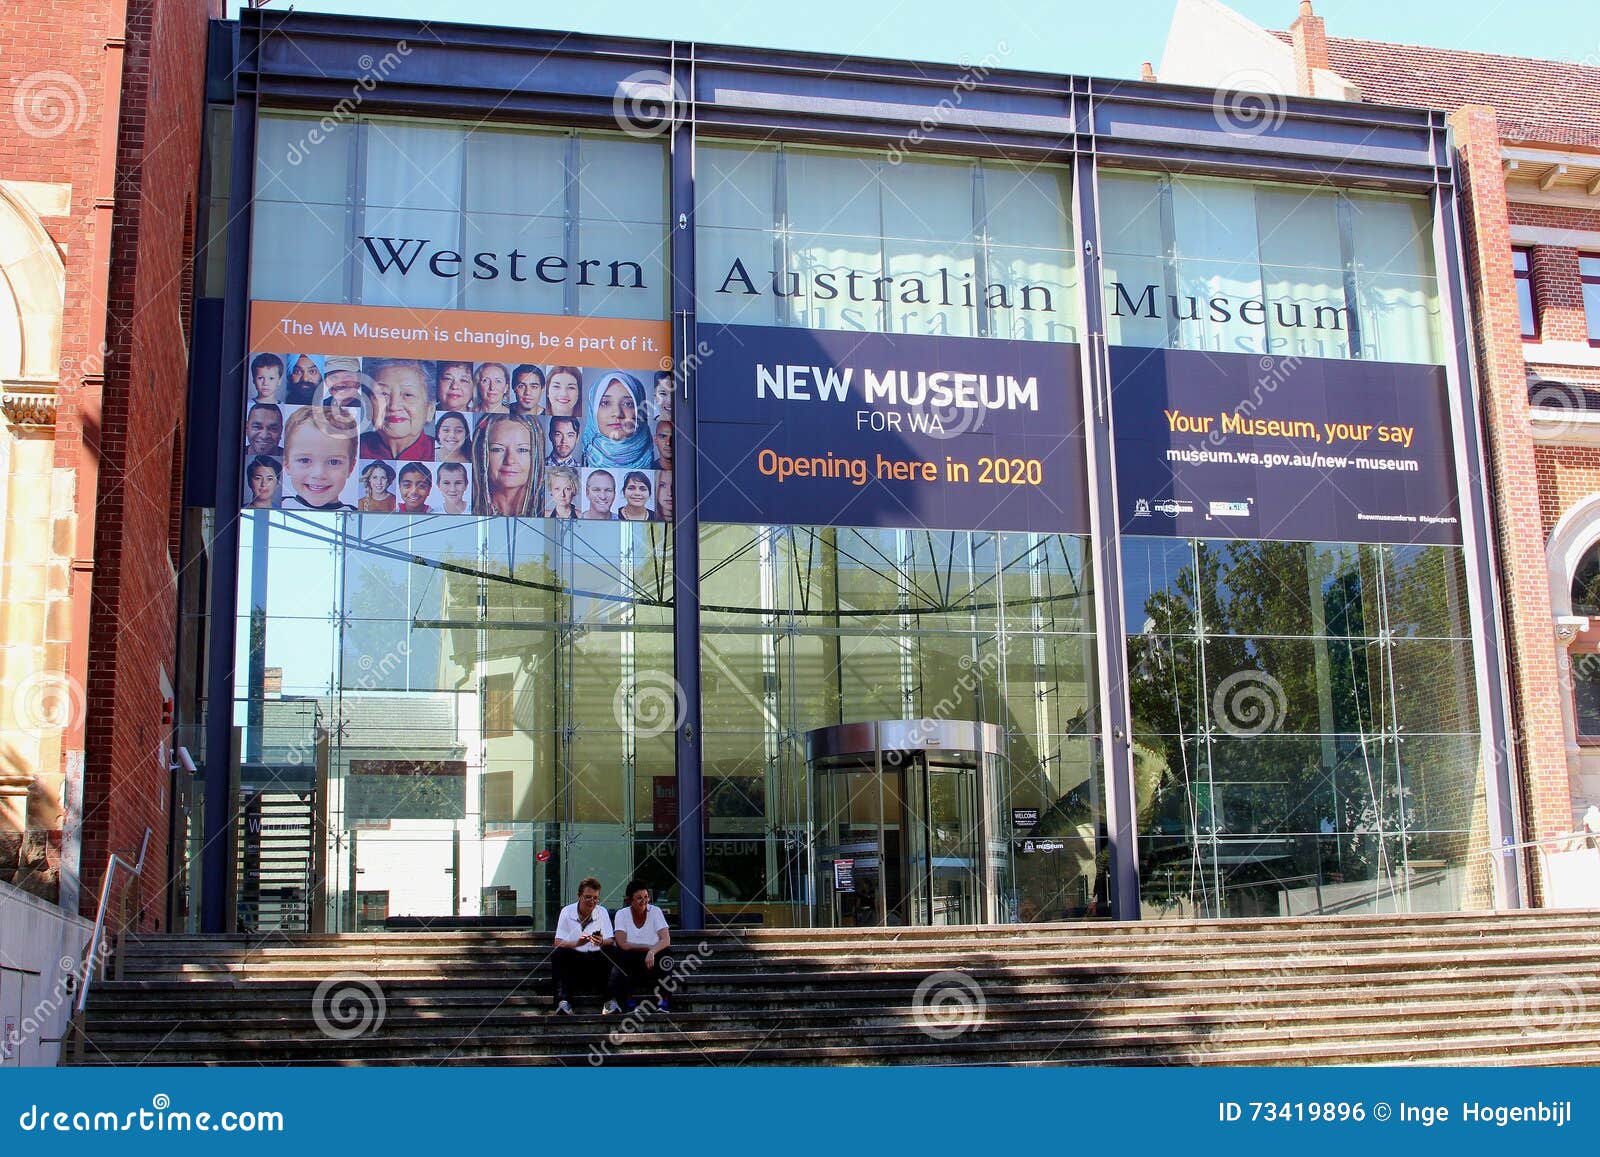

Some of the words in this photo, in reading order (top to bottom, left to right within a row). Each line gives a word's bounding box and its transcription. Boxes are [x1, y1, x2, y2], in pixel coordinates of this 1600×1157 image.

[358, 236, 648, 289] Western
[715, 256, 1057, 312] Australian
[1110, 281, 1358, 331] Museum
[281, 319, 313, 336] The
[319, 320, 347, 337] WA
[353, 323, 429, 341] Museum
[434, 326, 449, 342] is
[454, 328, 535, 348] changing,
[539, 332, 560, 347] be
[564, 336, 574, 347] a
[579, 336, 616, 352] part
[620, 336, 637, 350] of
[641, 337, 659, 352] it.
[756, 363, 854, 402] NEW
[864, 368, 1038, 411] MUSEUM
[856, 410, 902, 432] FOR
[907, 412, 945, 434] WA
[1164, 409, 1214, 434] Your
[1220, 412, 1321, 442] Museum,
[1324, 421, 1374, 445] your
[1378, 424, 1414, 447] say
[757, 448, 867, 486] Opening
[876, 454, 938, 482] here
[946, 456, 969, 482] in
[977, 457, 1043, 485] 2020
[1166, 448, 1419, 472] museum.wa.gov.au/new-museum
